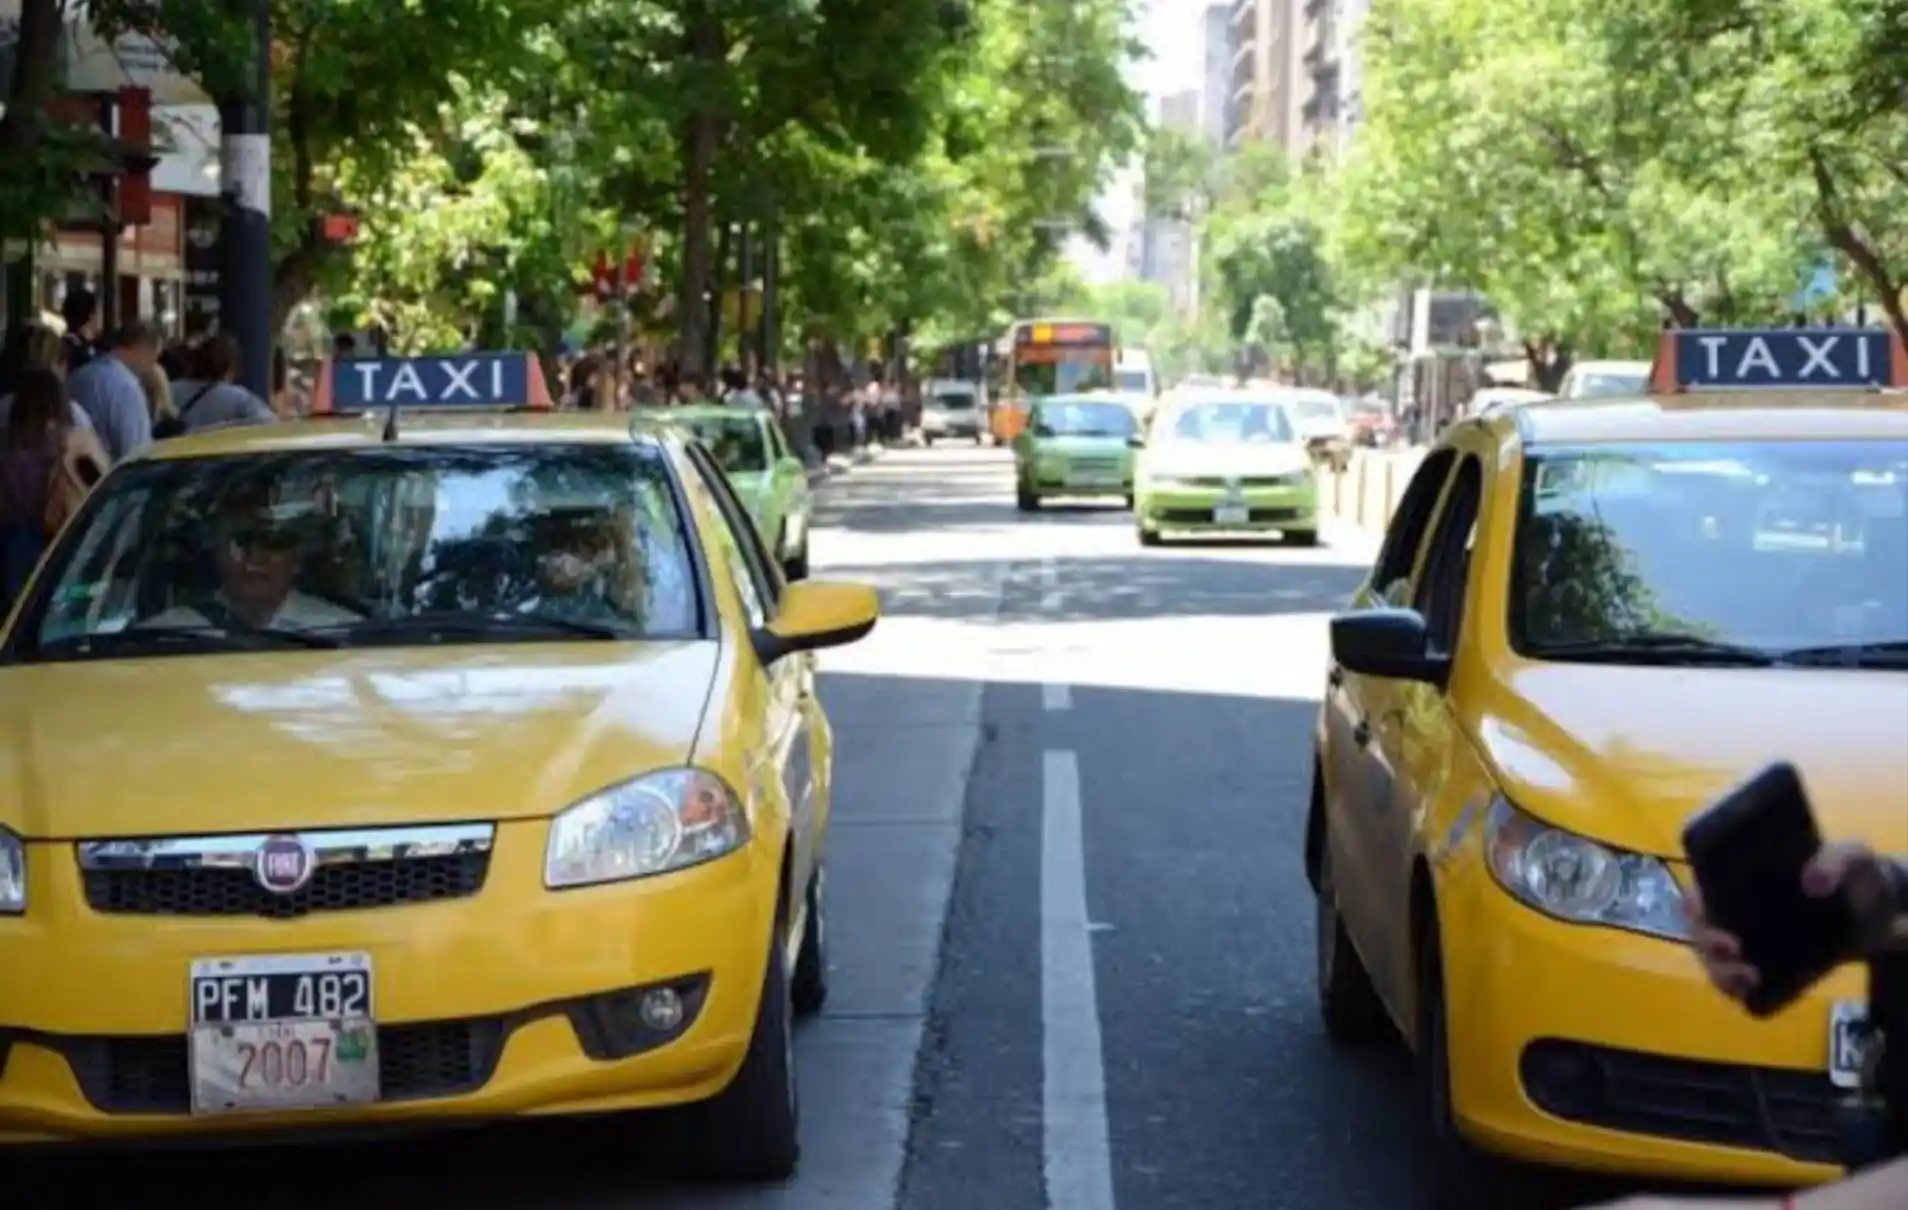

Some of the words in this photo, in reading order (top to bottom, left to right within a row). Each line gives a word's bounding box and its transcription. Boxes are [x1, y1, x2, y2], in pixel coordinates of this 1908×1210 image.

[1698, 336, 1869, 377] TAXI
[354, 359, 503, 401] TAXI
[268, 852, 298, 877] FIAT
[198, 977, 269, 1021] PFM
[294, 974, 365, 1018] 482
[237, 1038, 331, 1087] 2007
